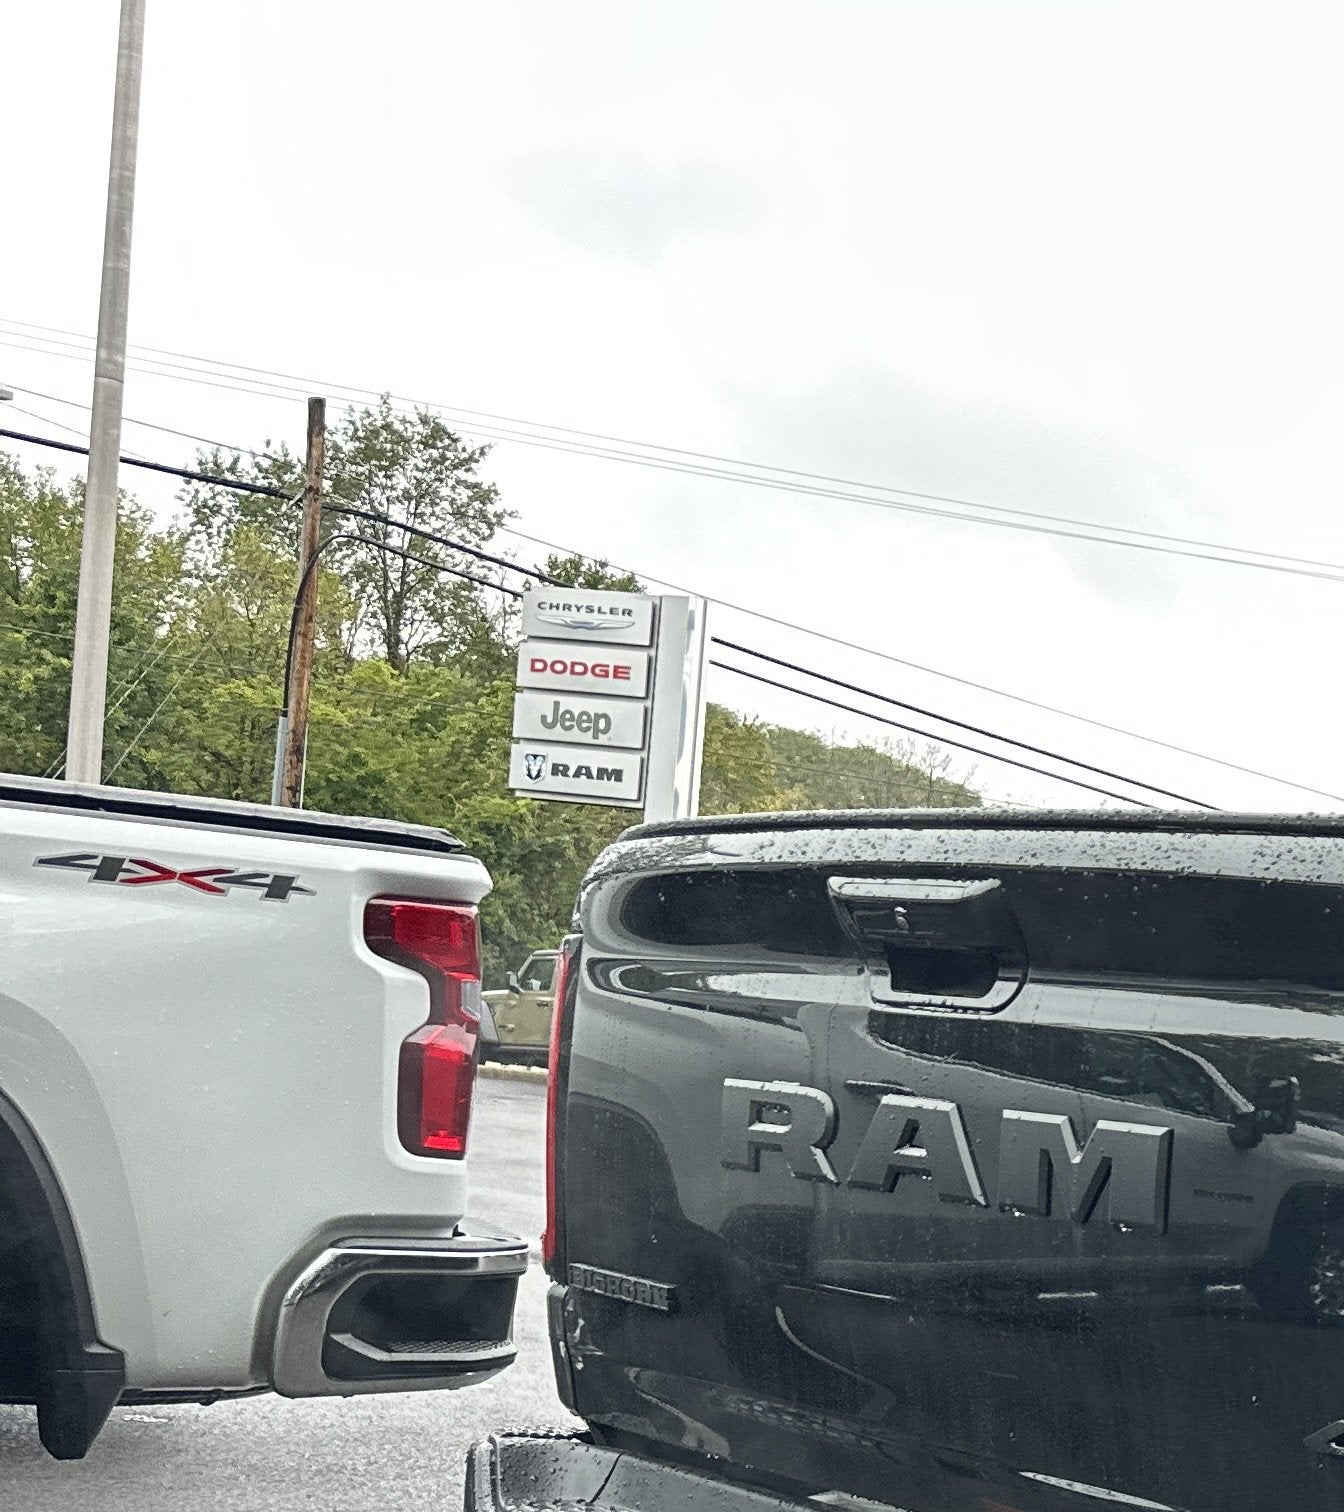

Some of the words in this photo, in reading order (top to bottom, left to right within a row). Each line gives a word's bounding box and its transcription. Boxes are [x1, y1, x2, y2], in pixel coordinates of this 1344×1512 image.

[537, 601, 634, 618] CHRYSLER
[530, 658, 632, 681] DODGE
[540, 701, 612, 739] Jeep
[550, 763, 624, 783] RAM
[721, 1077, 1174, 1233] RAM
